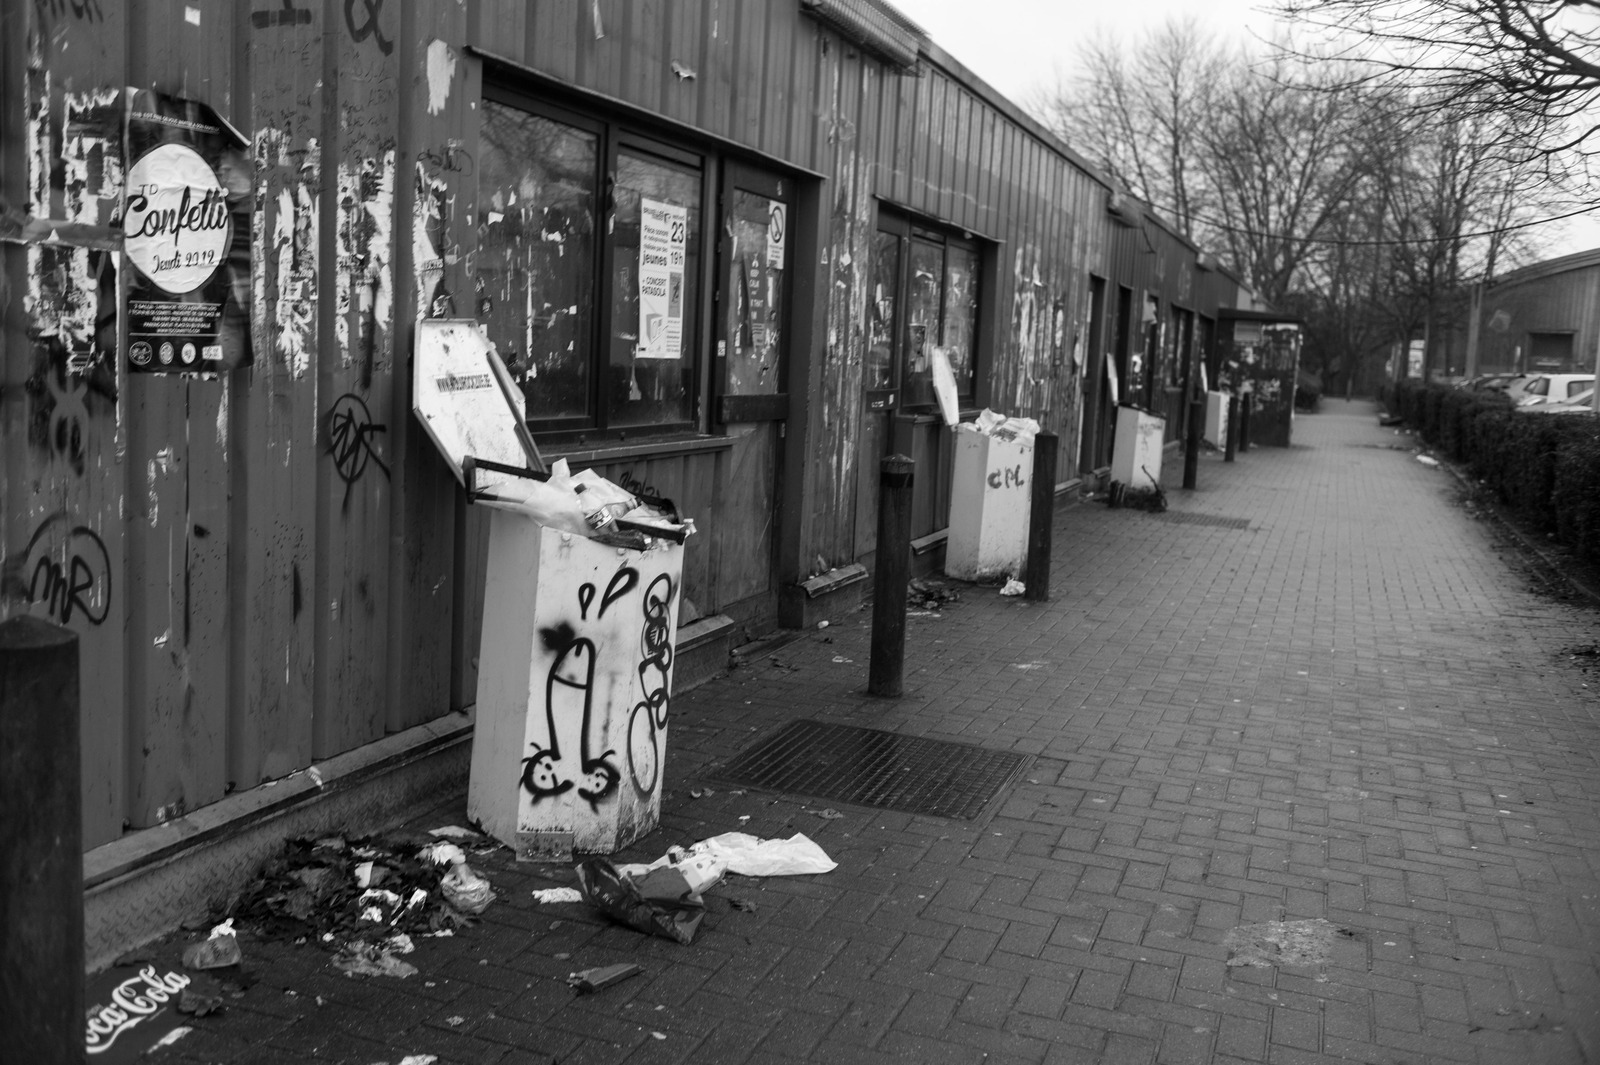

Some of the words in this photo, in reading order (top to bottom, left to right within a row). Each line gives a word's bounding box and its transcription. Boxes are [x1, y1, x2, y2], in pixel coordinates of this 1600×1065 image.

[125, 185, 228, 247] Confetti
[671, 221, 684, 243] 23
[152, 250, 181, 274] Jeudi
[642, 250, 667, 267] jeunes
[646, 276, 667, 286] CONCERT
